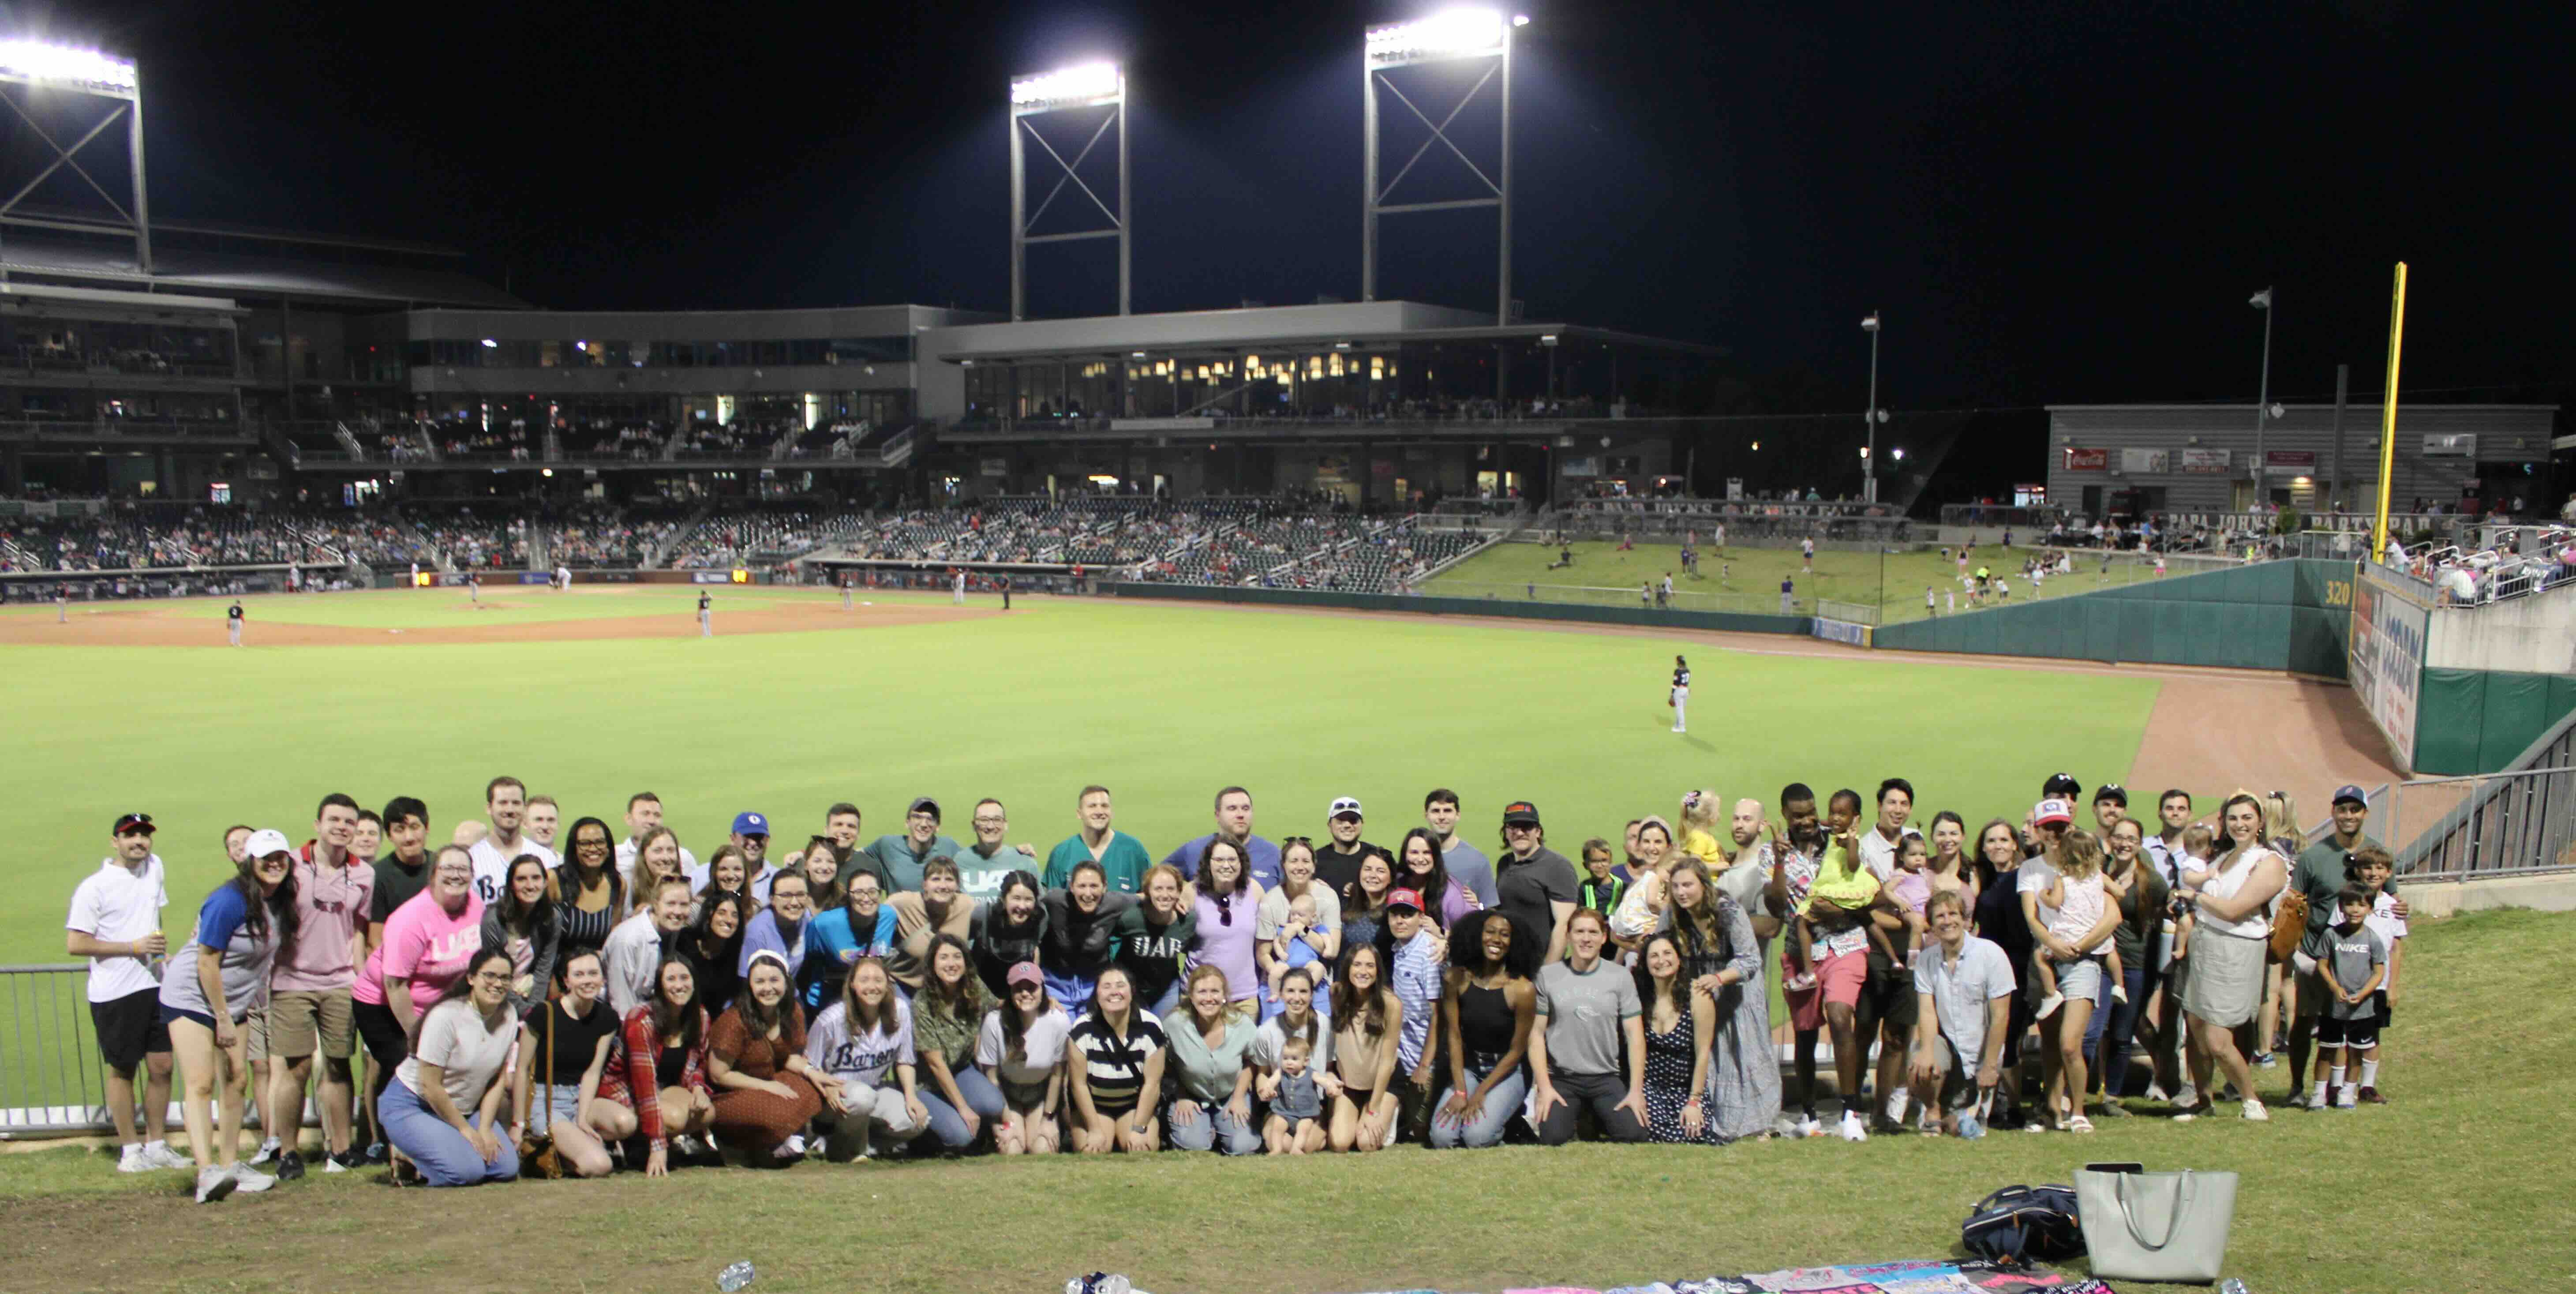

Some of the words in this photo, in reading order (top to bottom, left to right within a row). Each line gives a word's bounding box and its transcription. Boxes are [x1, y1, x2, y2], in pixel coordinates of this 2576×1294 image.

[2169, 514, 2209, 531] PAPA
[2311, 515, 2377, 532] PARTY
[2325, 580, 2350, 605] 320
[962, 869, 1014, 892] UA
[431, 925, 482, 961] UAB
[2335, 943, 2370, 953] NIKE
